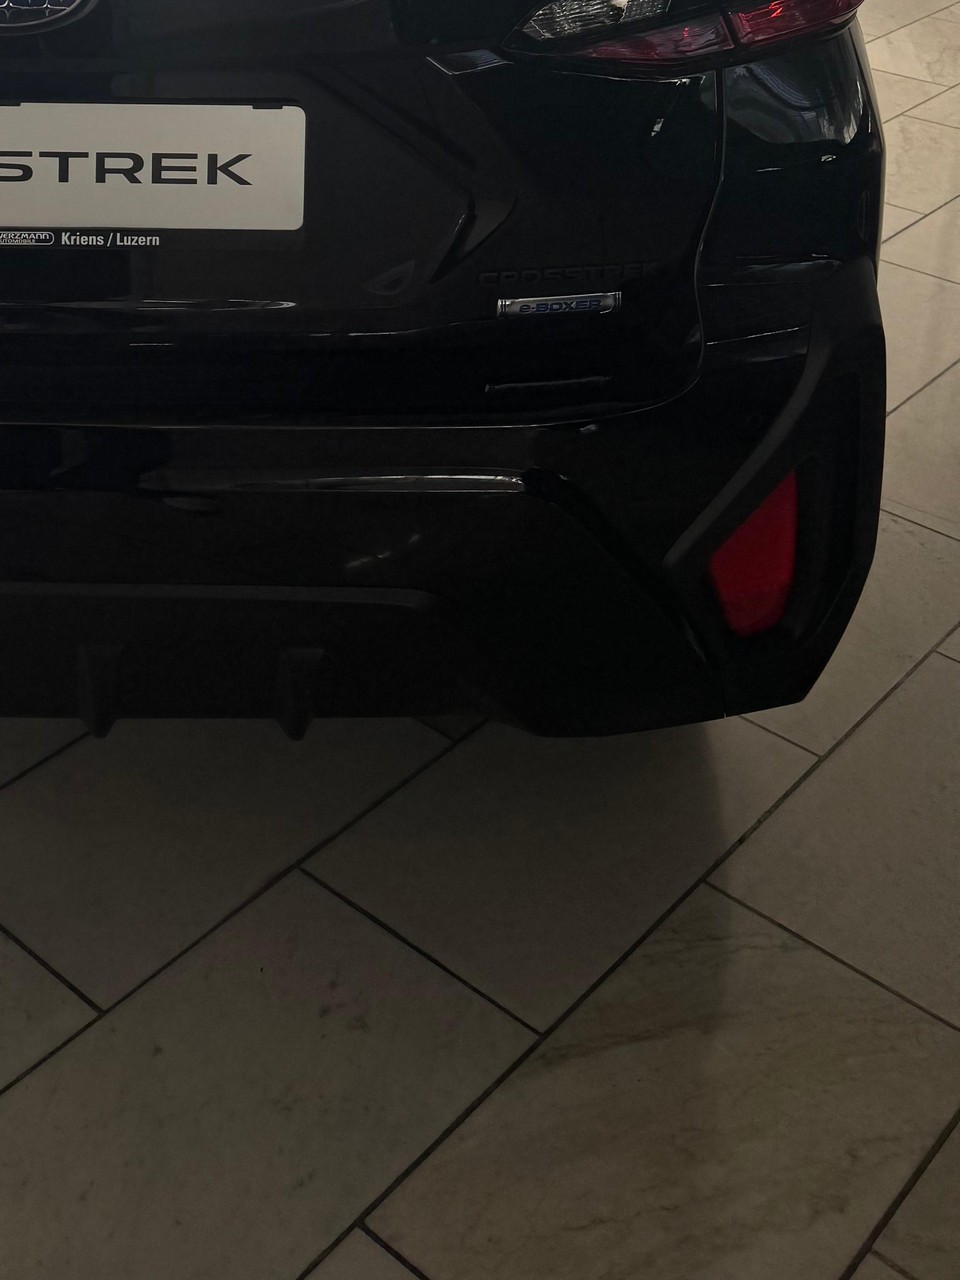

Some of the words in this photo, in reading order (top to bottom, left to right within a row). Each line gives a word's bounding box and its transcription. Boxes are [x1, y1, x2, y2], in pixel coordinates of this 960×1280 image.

[61, 232, 105, 246] Kriens
[116, 232, 160, 247] Luzern
[518, 299, 602, 315] e-BOXER
